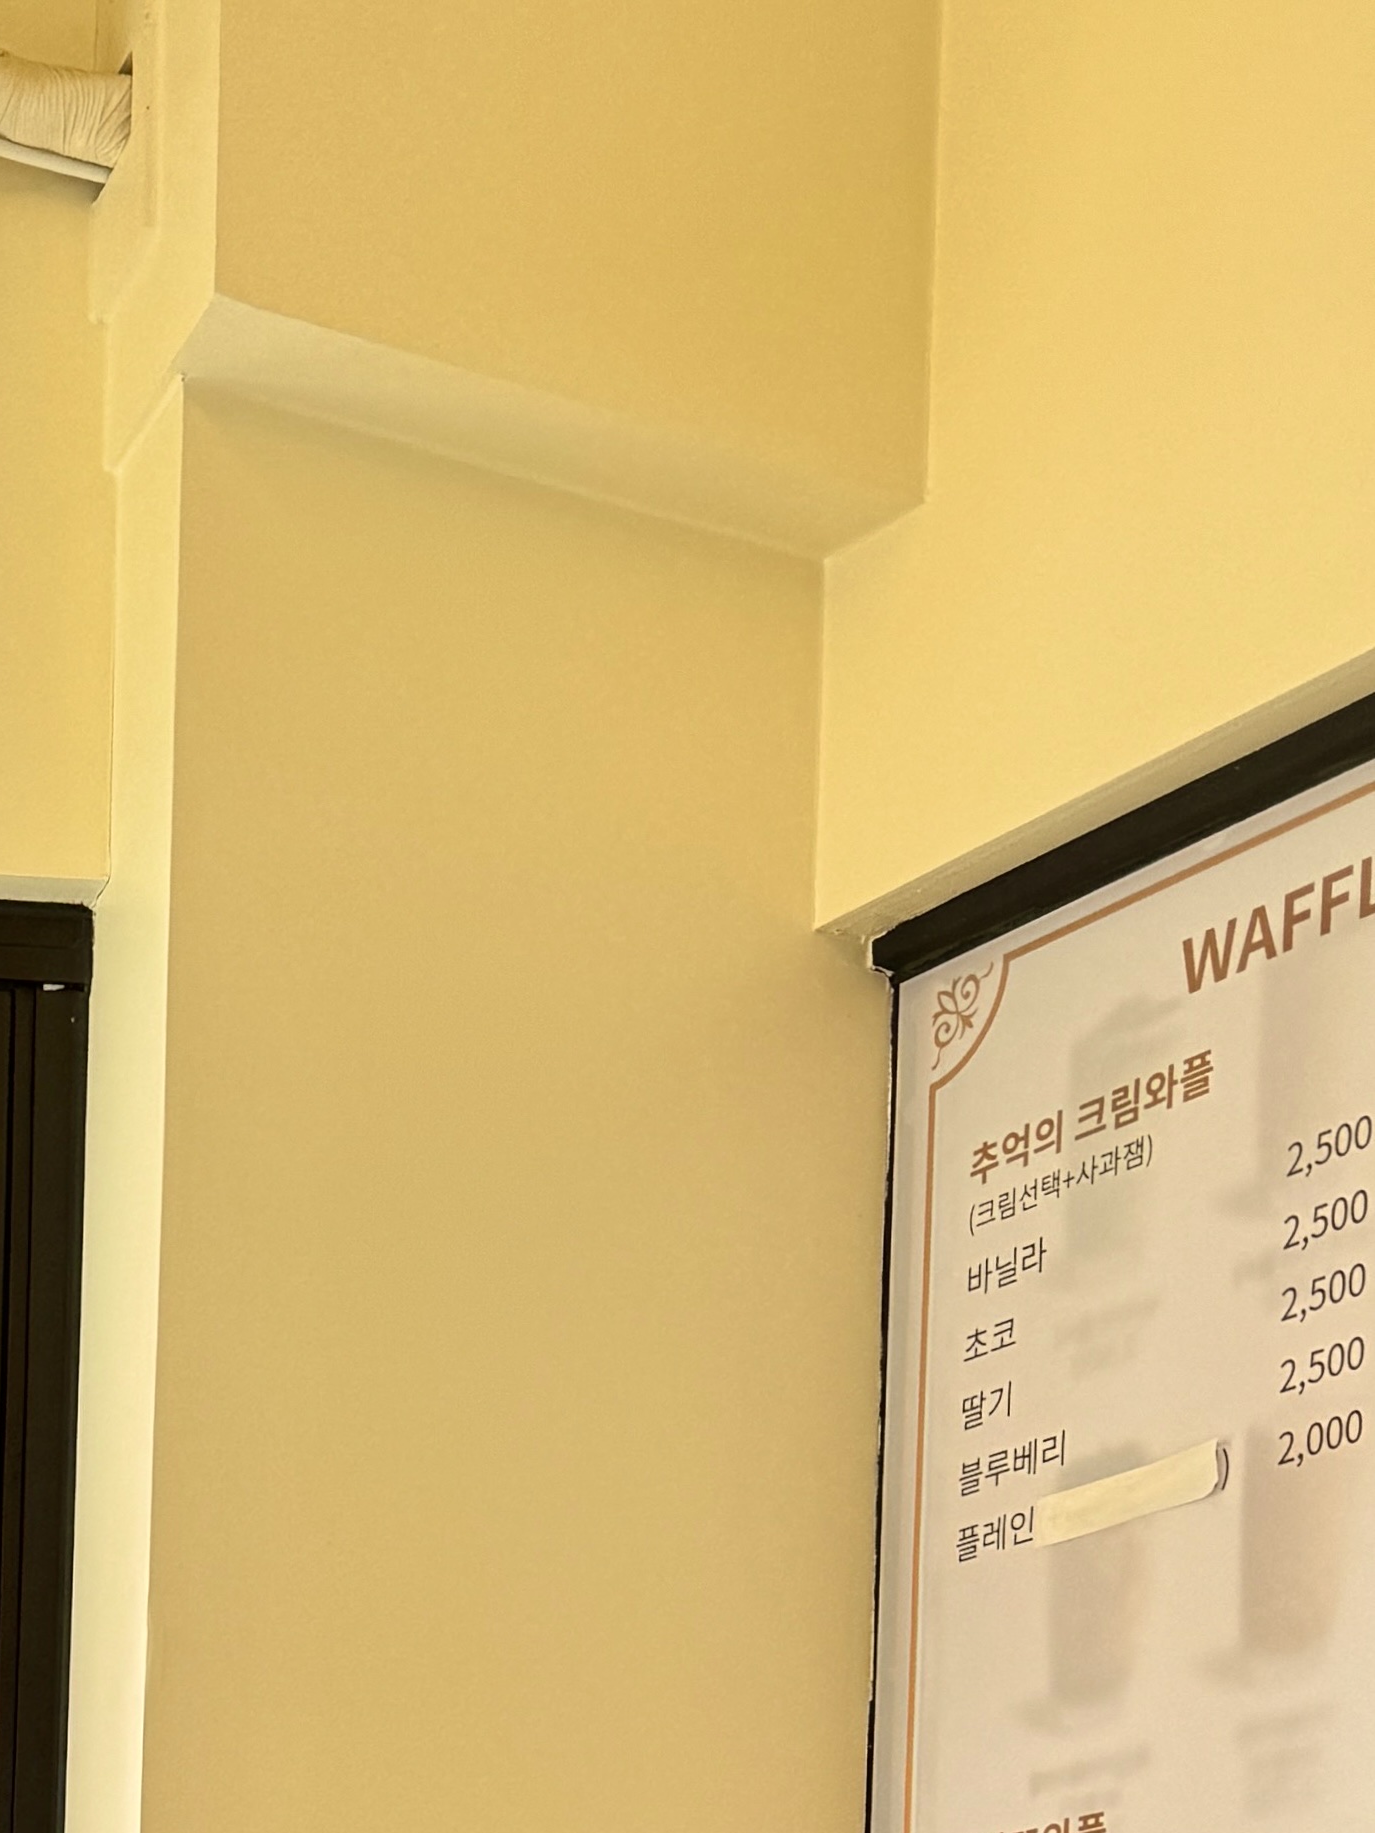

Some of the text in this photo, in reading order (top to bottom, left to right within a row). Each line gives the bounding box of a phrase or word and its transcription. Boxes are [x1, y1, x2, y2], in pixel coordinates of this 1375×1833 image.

[968, 1133, 1154, 1237] (크림선택+사과잼)
[969, 1048, 1215, 1186] 추억의 크림와플
[963, 1188, 1369, 1363] 초코 2,500
[967, 1114, 1374, 1295] 바닐라 2,500
[958, 1336, 1366, 1497] 블루베리 2,500
[961, 1262, 1367, 1431] 딸기 2,500
[955, 1409, 1364, 1563] 플레인 2,000
